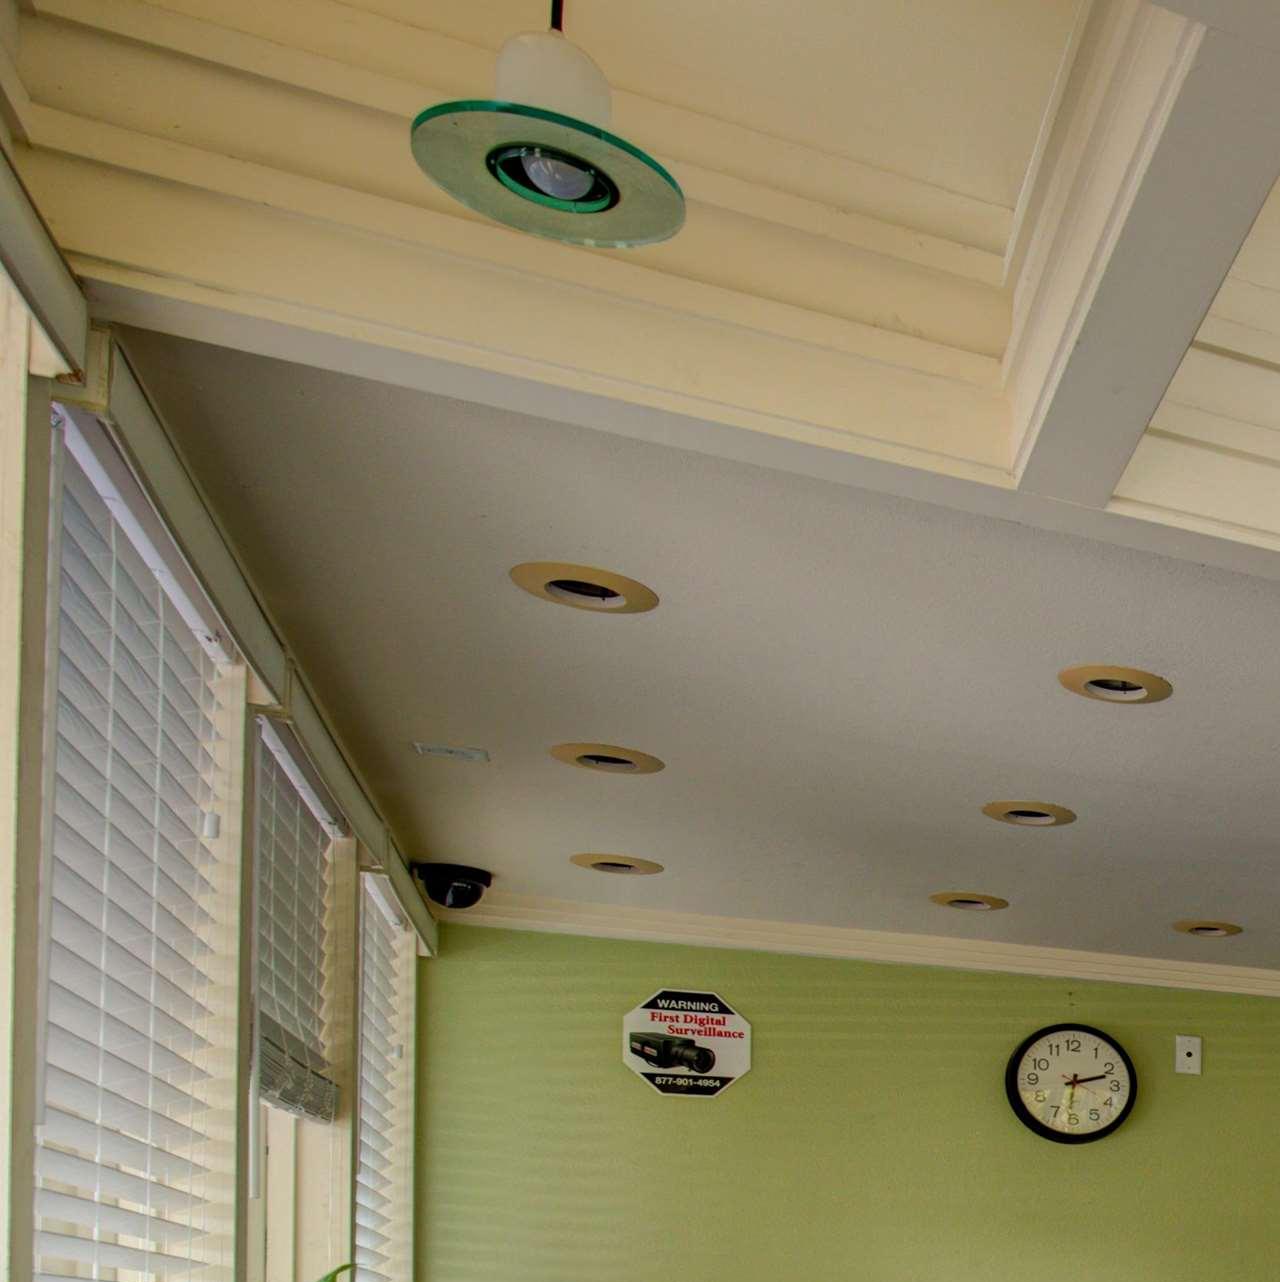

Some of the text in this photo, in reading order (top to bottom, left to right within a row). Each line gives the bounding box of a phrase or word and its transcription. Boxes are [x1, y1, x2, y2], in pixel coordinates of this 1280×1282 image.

[657, 998, 720, 1012] WARNING
[650, 1012, 727, 1027] First Digital
[667, 1024, 745, 1039] Surveillance
[1048, 1043, 1060, 1056] 11
[1065, 1039, 1081, 1052] 12
[1032, 1058, 1049, 1071] 10
[1104, 1062, 1114, 1075] 2
[1027, 1072, 1039, 1085] 9
[1110, 1080, 1120, 1092] 3
[1034, 1090, 1046, 1102] 8
[1103, 1096, 1113, 1108] 4
[1050, 1105, 1060, 1118] 7
[1089, 1108, 1100, 1121] 5
[1068, 1113, 1079, 1126] 6
